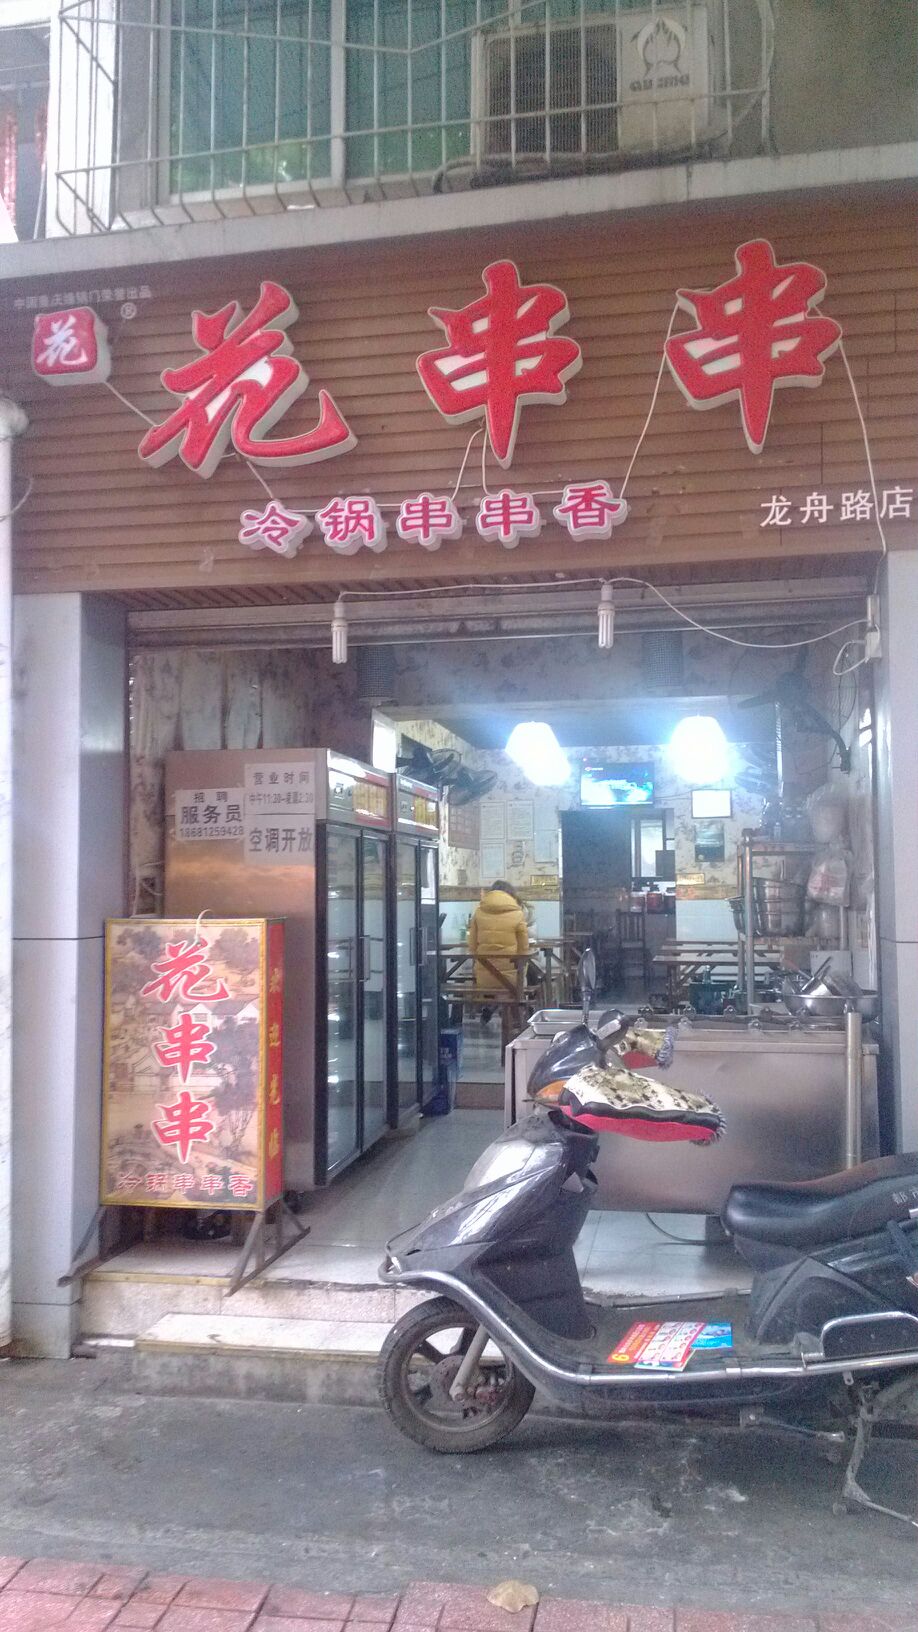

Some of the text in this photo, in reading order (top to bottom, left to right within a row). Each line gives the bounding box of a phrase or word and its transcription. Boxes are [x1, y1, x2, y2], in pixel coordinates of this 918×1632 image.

[36, 314, 88, 367] 花
[138, 239, 843, 478] 花串串
[239, 482, 624, 553] 冷锅串串香
[759, 486, 914, 528] 龙舟路店
[181, 804, 243, 824] 服务员
[249, 827, 312, 853] 空调开放
[140, 937, 231, 1164] 花串串
